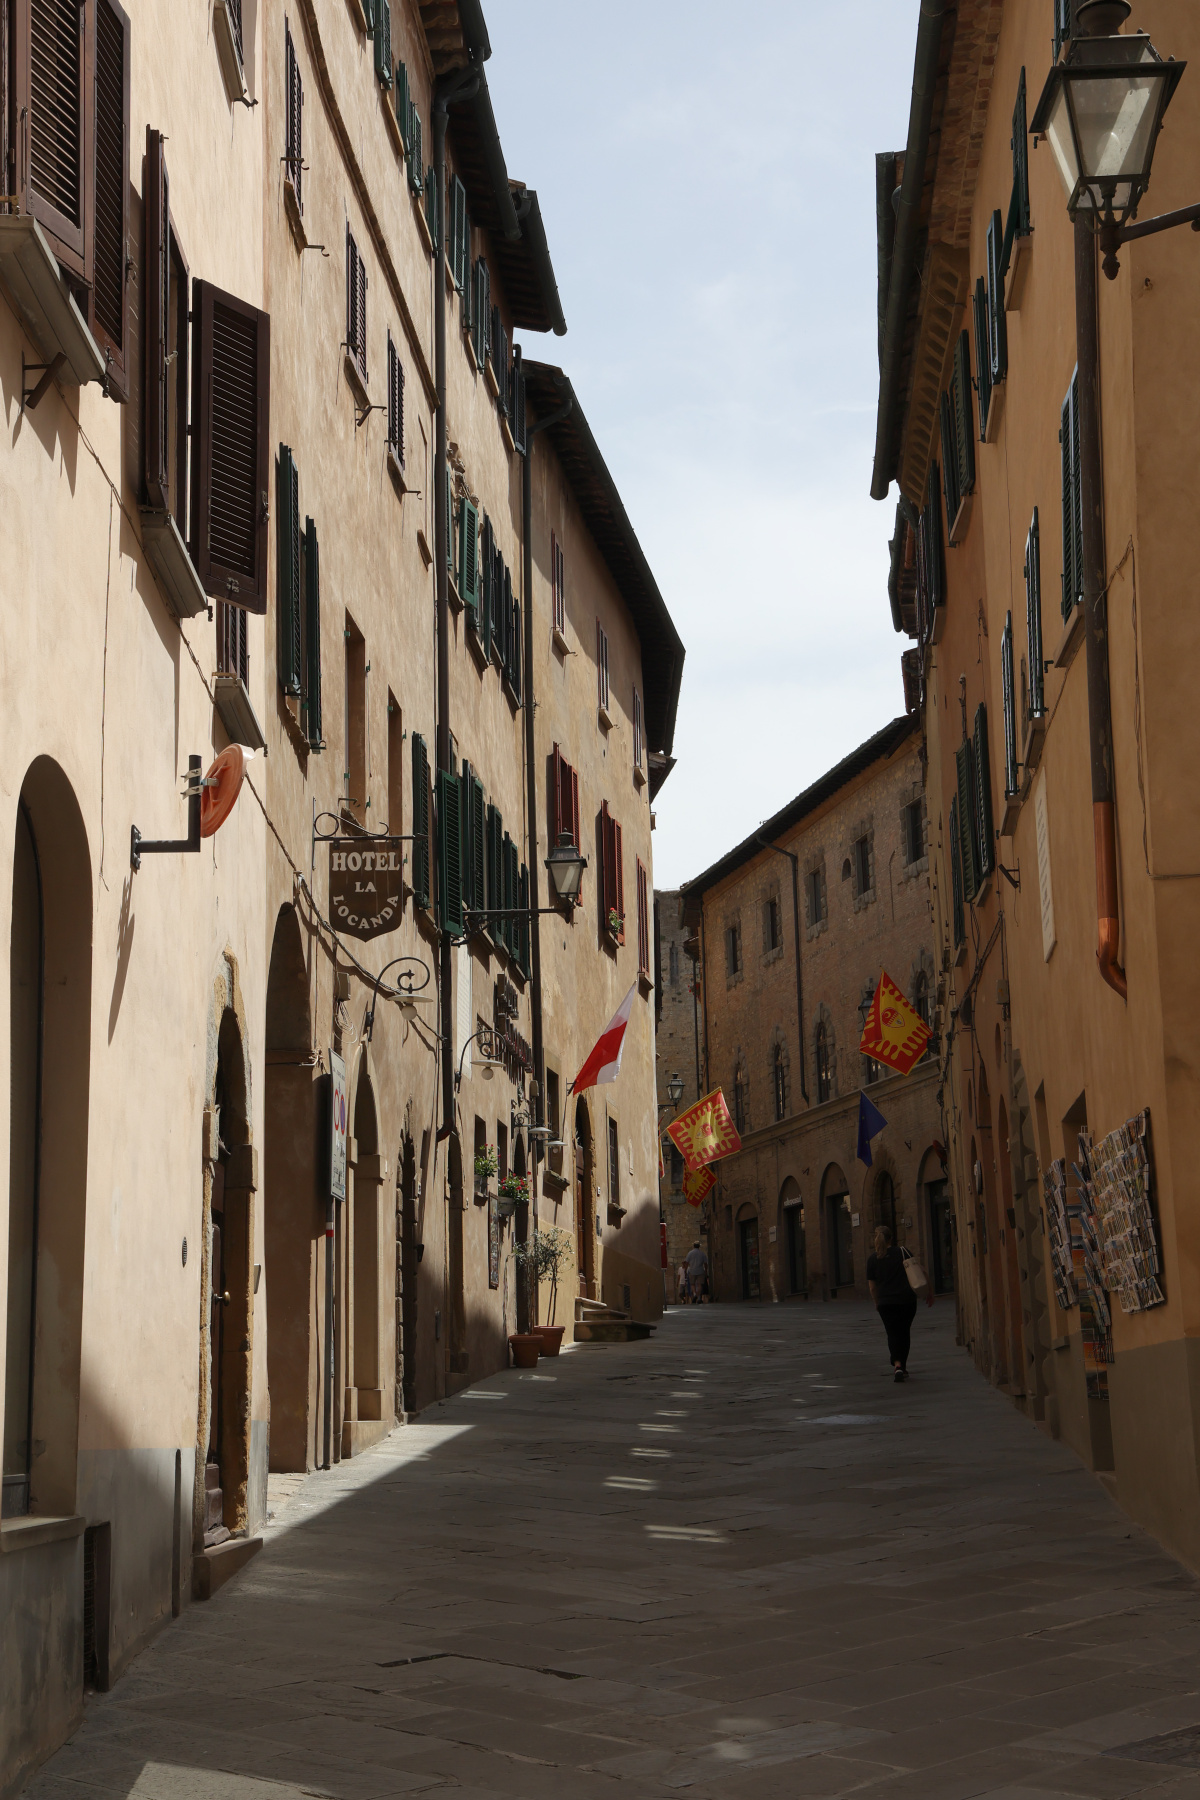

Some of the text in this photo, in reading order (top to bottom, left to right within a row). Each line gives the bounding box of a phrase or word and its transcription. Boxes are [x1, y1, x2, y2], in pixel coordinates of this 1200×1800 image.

[332, 851, 400, 871] HOTEL
[355, 881, 376, 893] LA
[333, 895, 398, 929] LOCANDA
